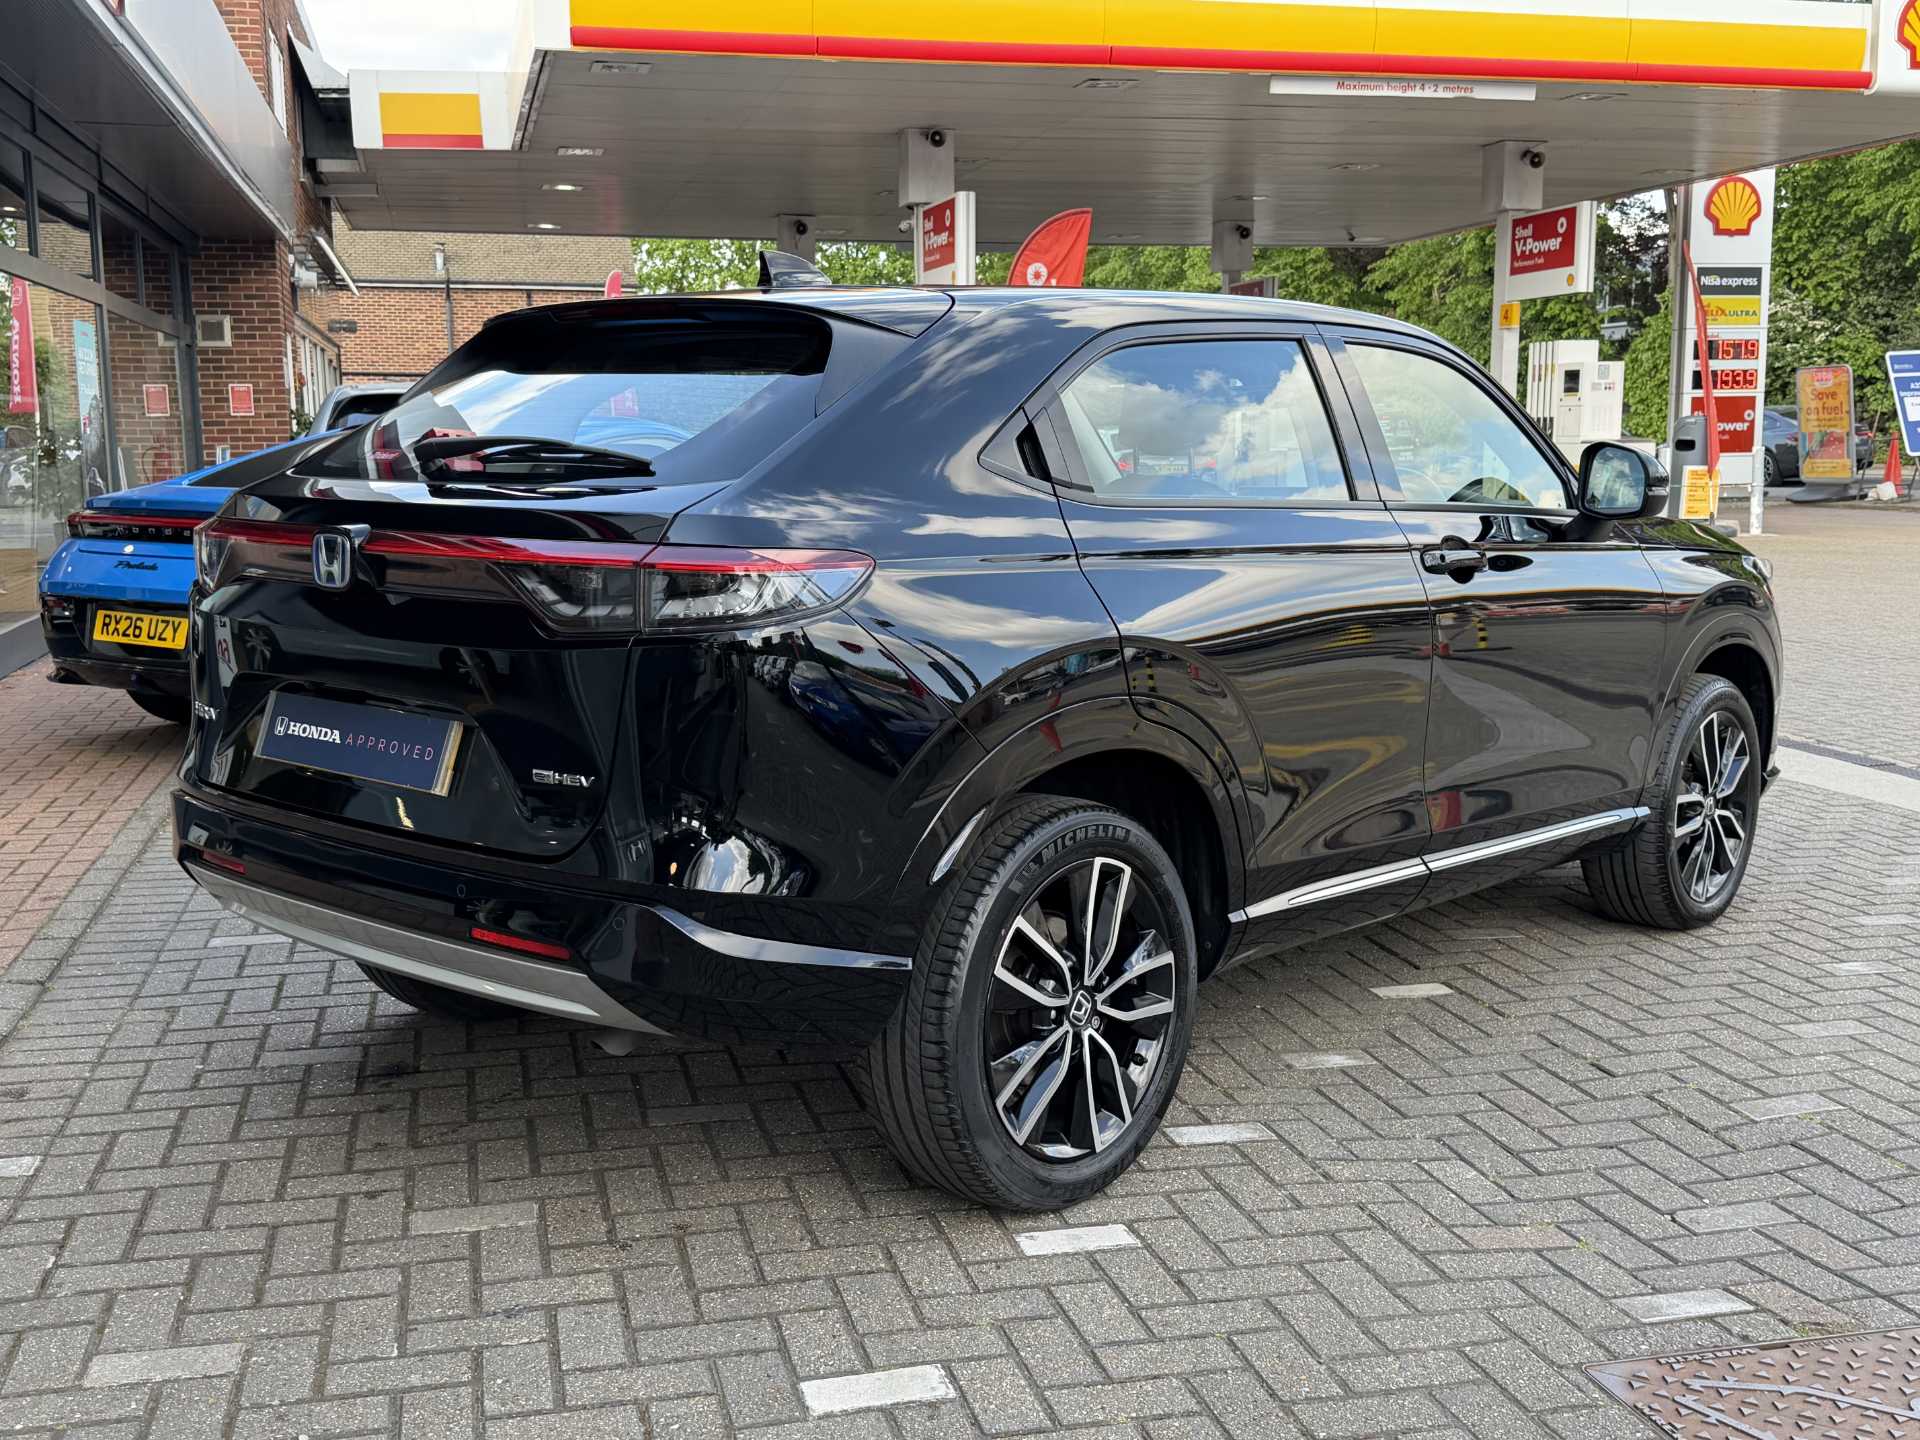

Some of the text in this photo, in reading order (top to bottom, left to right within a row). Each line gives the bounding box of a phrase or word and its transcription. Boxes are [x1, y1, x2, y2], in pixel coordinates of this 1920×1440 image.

[1336, 81, 1384, 92] Maximum
[1387, 81, 1417, 94] height
[1442, 84, 1474, 95] metres
[1515, 223, 1533, 239] Shell
[1515, 236, 1563, 256] V-Power
[1721, 277, 1758, 287] express
[1503, 308, 1509, 321] 4
[1728, 309, 1758, 317] ULTRA
[1718, 340, 1759, 359] 157.9
[1716, 370, 1757, 389] 193.9
[1810, 388, 1838, 400] Save
[1806, 401, 1844, 416] on fuel
[101, 614, 182, 643] RX26 UZY
[287, 721, 434, 761] HONDA APPROVED
[1041, 825, 1127, 863] MICHELIN
